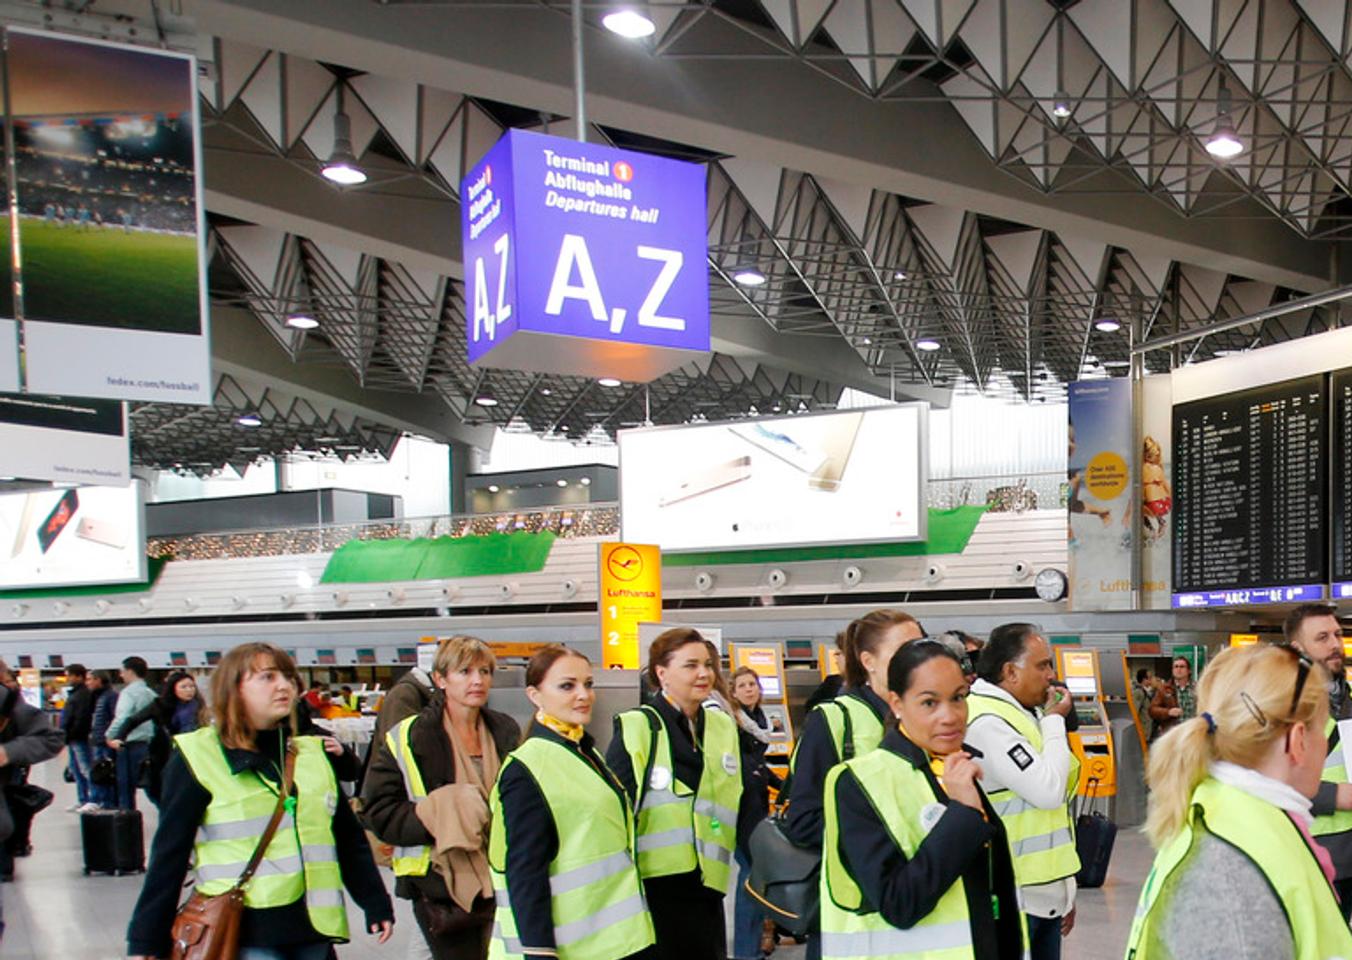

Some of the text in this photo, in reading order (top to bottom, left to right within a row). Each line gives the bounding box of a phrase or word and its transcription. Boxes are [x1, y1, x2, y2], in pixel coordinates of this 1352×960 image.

[544, 150, 609, 176] Terminal
[544, 172, 631, 200] Abflughalle
[545, 191, 659, 223] Departures hall
[473, 233, 512, 342] A,Z
[545, 234, 685, 333] A,Z
[608, 588, 656, 597] Lufthansa
[608, 605, 617, 619] 1
[608, 631, 620, 646] 2
